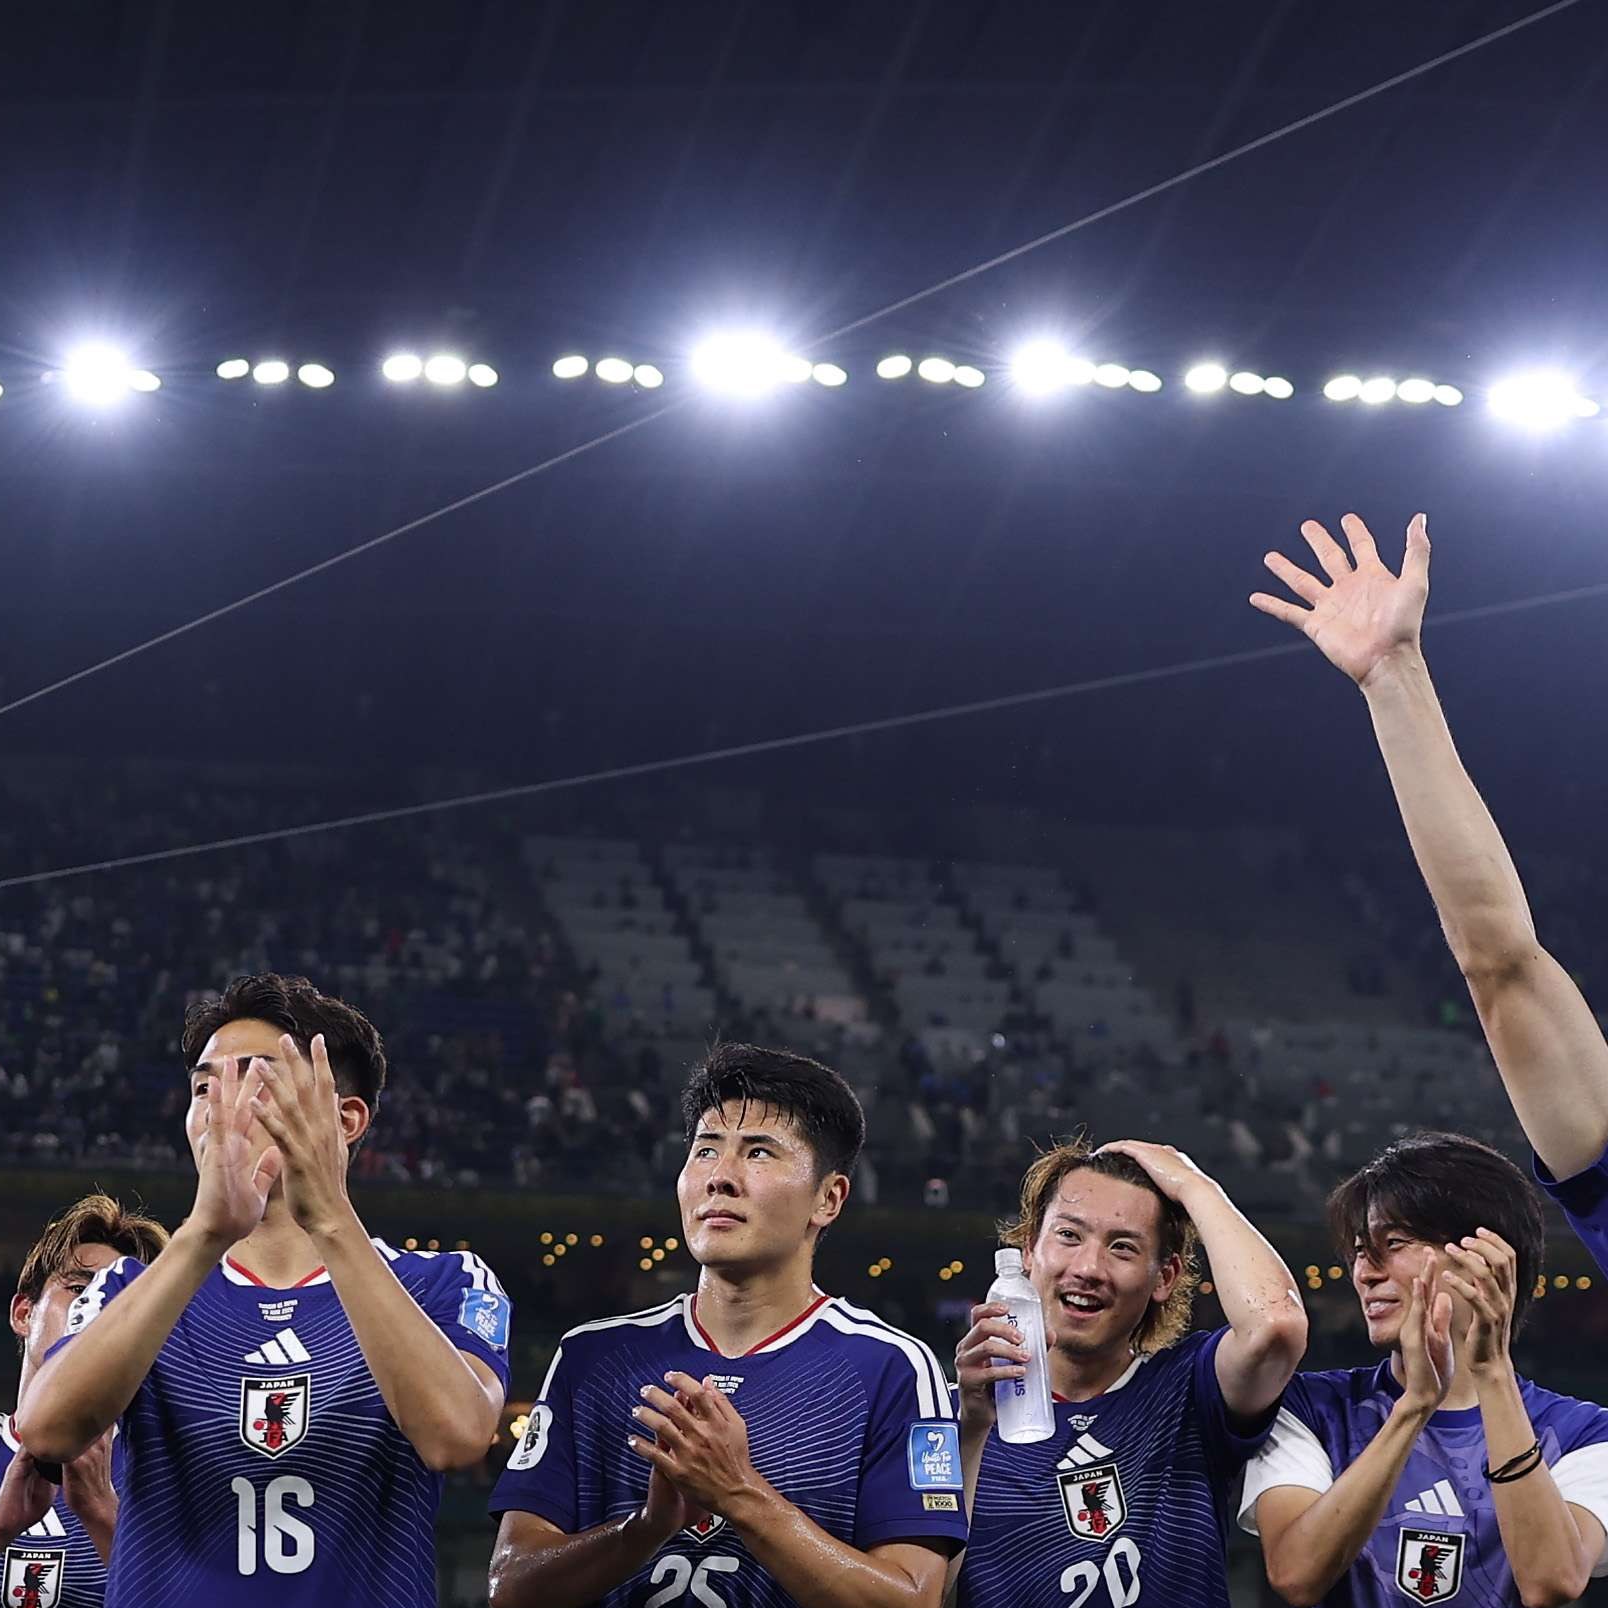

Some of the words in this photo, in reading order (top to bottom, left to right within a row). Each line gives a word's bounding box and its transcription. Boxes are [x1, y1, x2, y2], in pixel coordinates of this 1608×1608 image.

[259, 1379, 295, 1390] JAPAN
[924, 1463, 952, 1475] PEACE
[1072, 1469, 1104, 1482] JAPAN
[231, 1475, 315, 1576] 16
[1416, 1532, 1449, 1543] JAPAN
[21, 1551, 52, 1560] JAPAN
